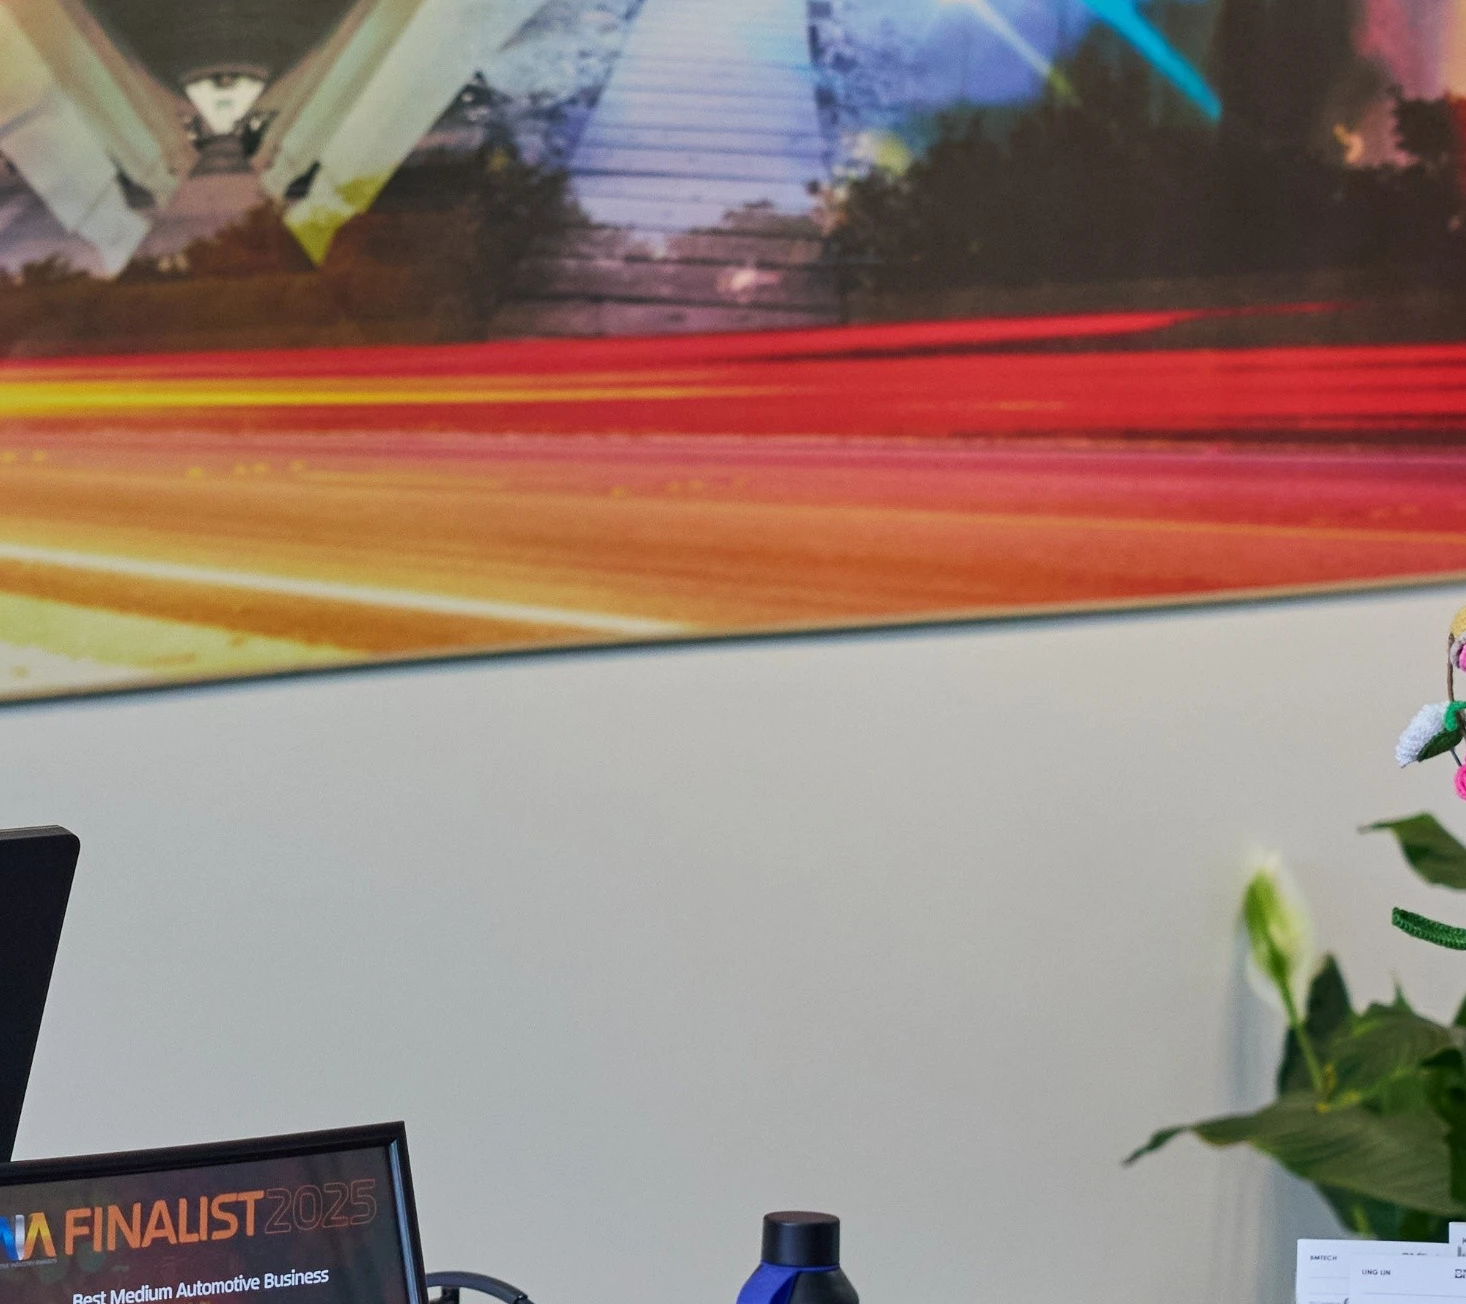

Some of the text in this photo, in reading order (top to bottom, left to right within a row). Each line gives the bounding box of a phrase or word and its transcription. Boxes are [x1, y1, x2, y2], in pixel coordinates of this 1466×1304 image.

[64, 1178, 377, 1256] FINALIST 2025
[176, 1274, 260, 1299] Automotive
[264, 1268, 330, 1289] Business
[1361, 1268, 1378, 1276] LING
